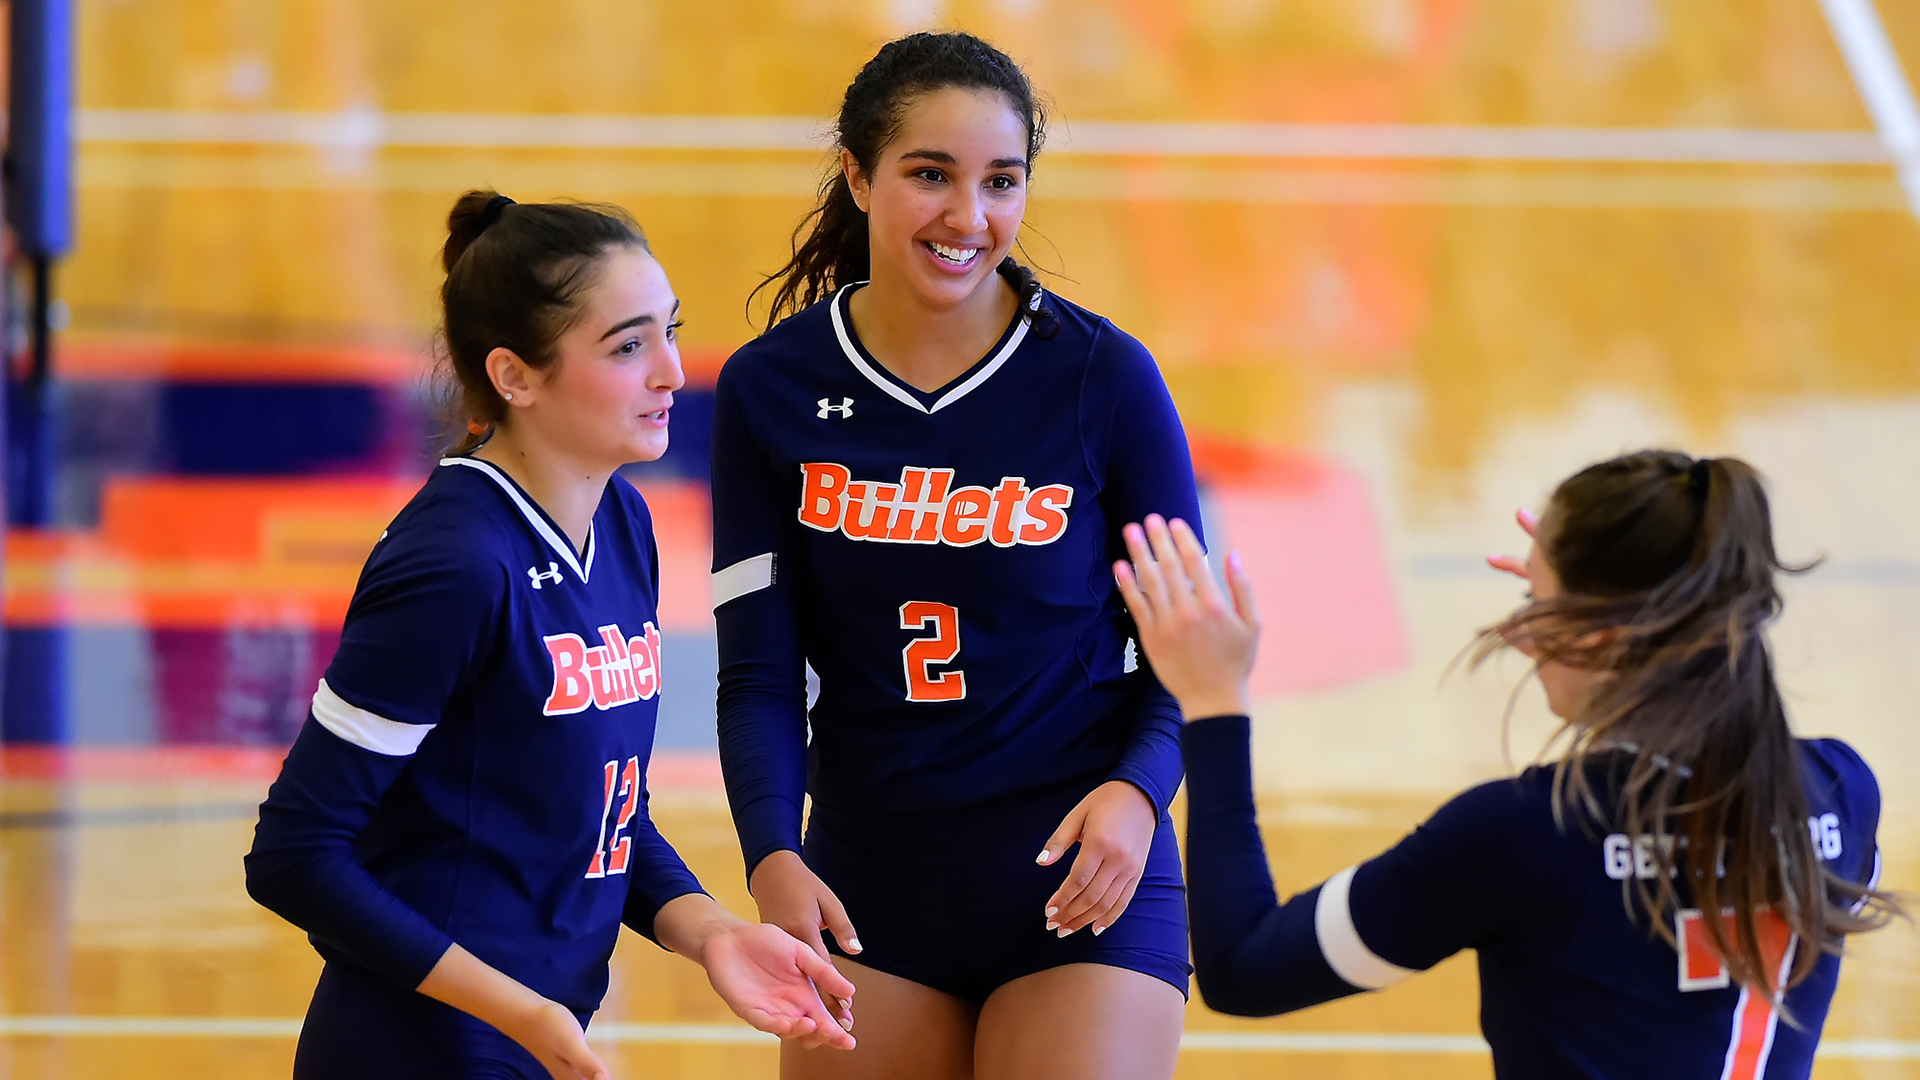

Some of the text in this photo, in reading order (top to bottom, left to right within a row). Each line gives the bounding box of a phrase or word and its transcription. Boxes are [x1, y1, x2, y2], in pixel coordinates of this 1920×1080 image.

[797, 462, 1075, 548] Bullets
[543, 620, 662, 716] Bullet
[899, 600, 967, 702] 2
[584, 755, 640, 879] 12
